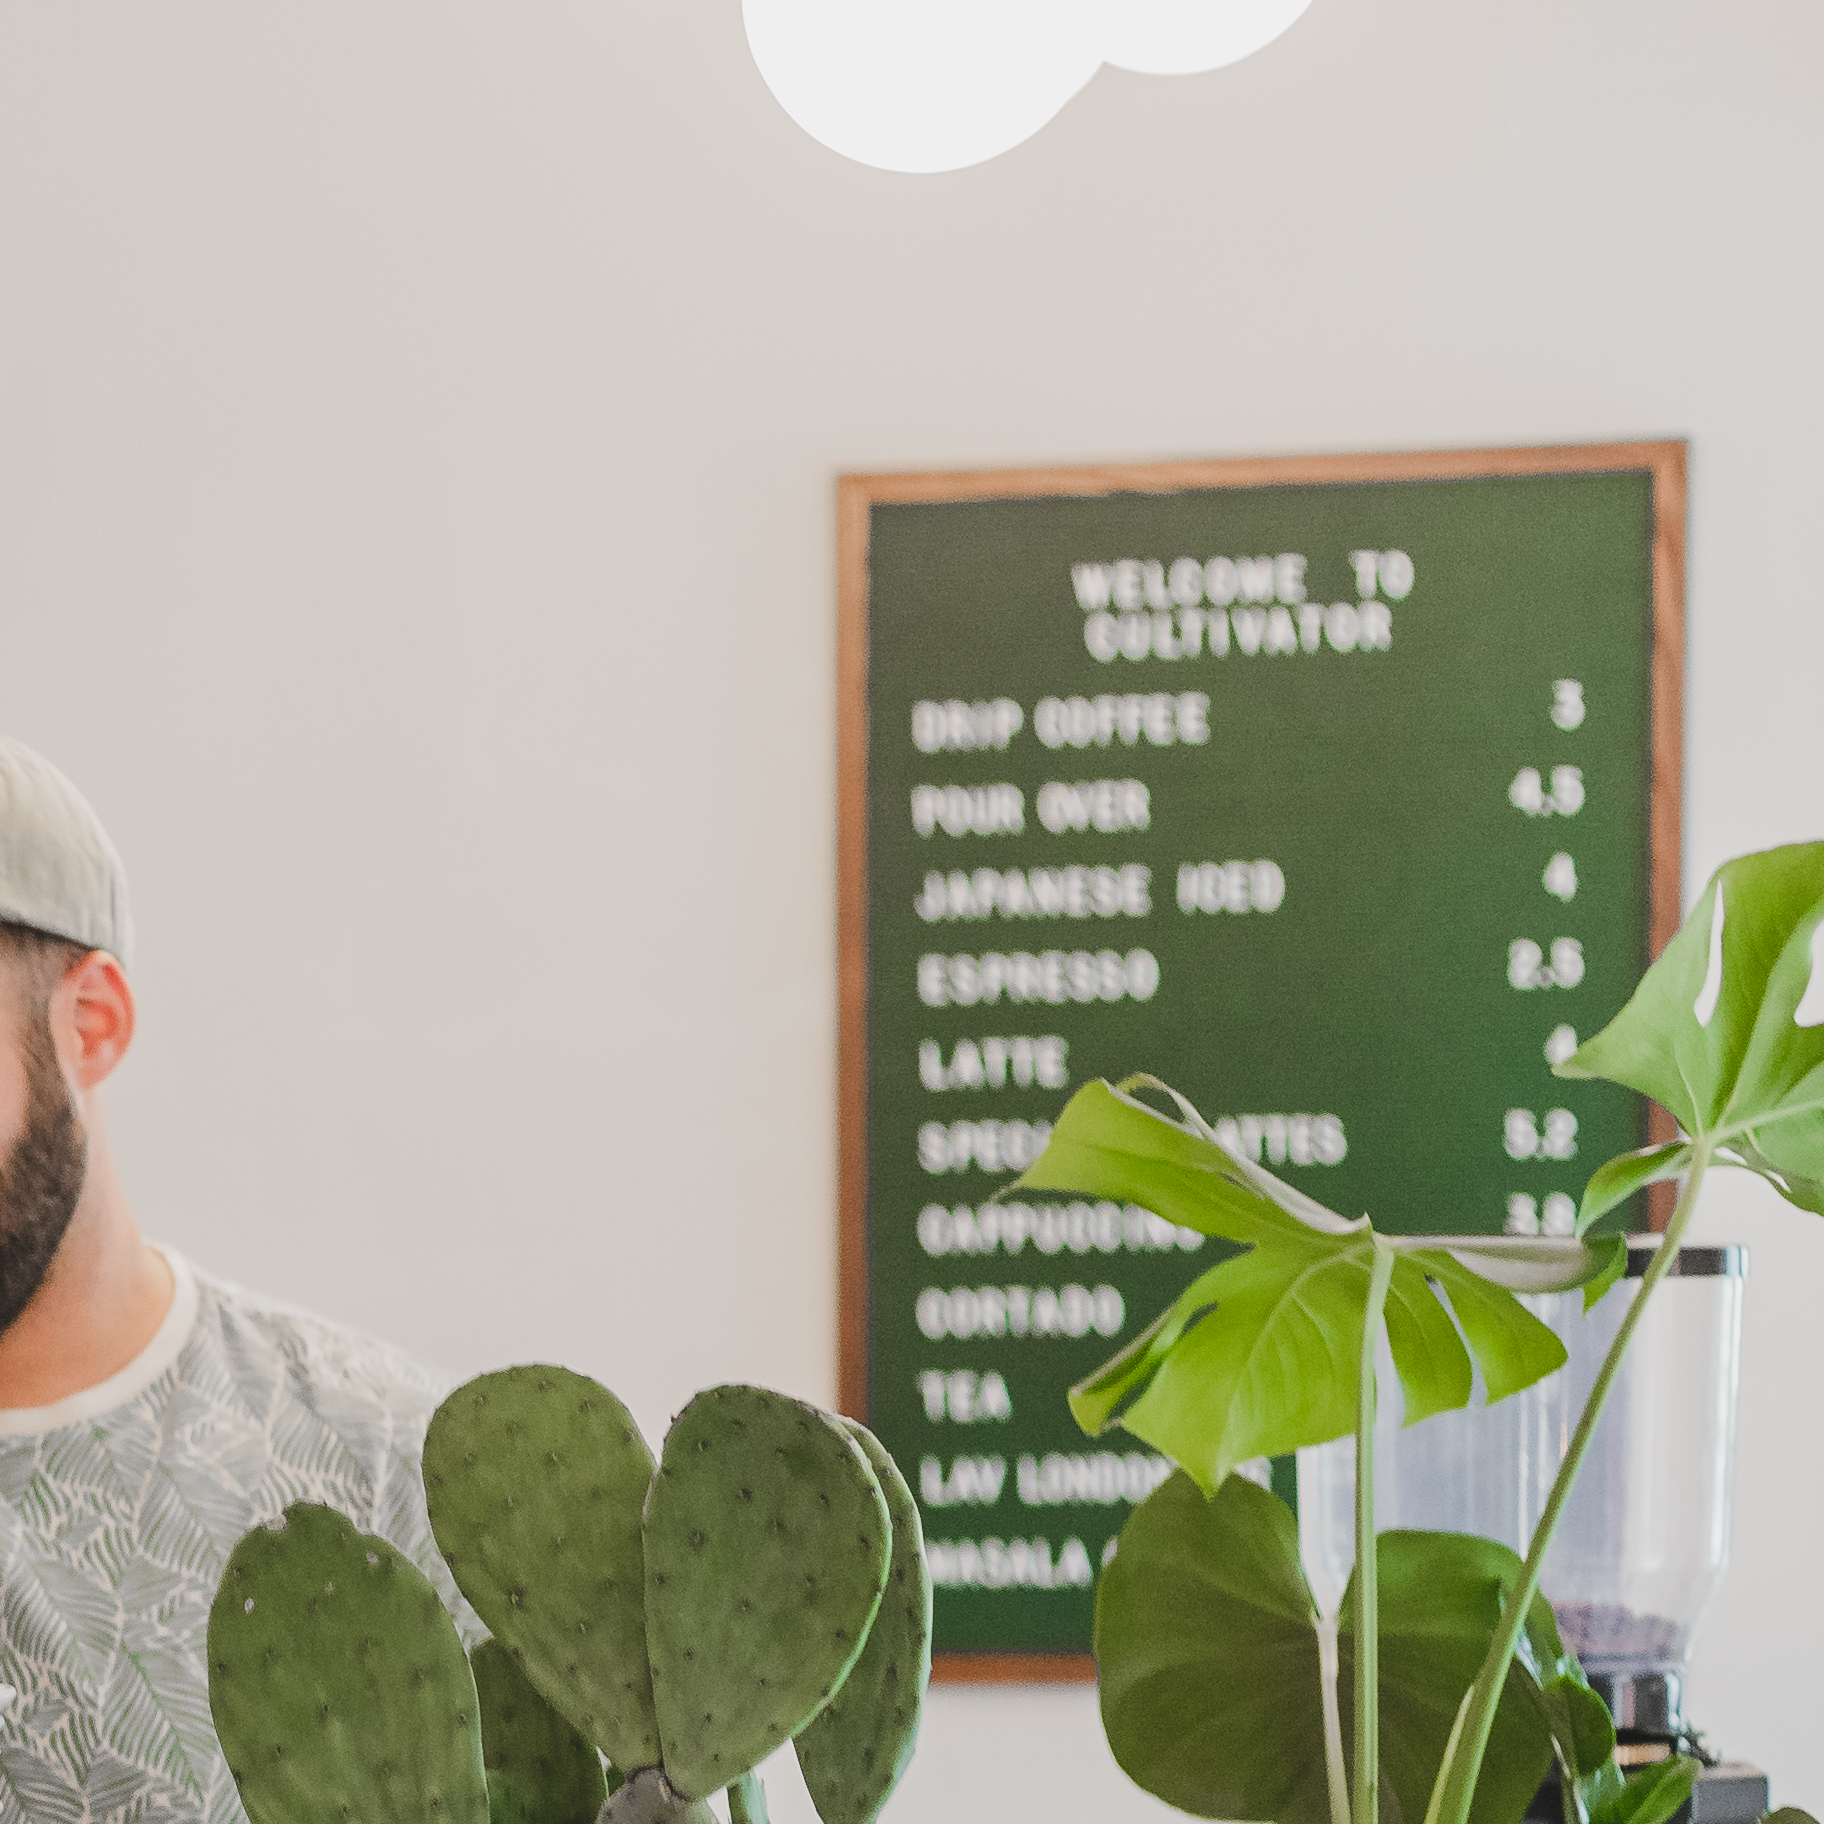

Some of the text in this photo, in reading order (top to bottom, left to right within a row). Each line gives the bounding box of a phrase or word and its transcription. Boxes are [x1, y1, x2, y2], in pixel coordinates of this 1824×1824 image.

[1071, 549, 1415, 609] WELCOME TO
[1083, 601, 1392, 662] CULTIVATOR
[911, 691, 1210, 753] DRIP COFFEE
[1551, 678, 1586, 731] 3
[911, 779, 1151, 837] POUR OVER
[1509, 765, 1586, 816] 4.5
[915, 859, 1286, 921] JAPANESE ICED
[1543, 852, 1578, 901] 4
[917, 949, 1160, 1006] ESPRESSO
[918, 1036, 1070, 1092] LATTE
[1504, 1109, 1578, 1160] 5.2
[916, 1284, 1125, 1338] CORTADO
[919, 1370, 1012, 1423] TEA
